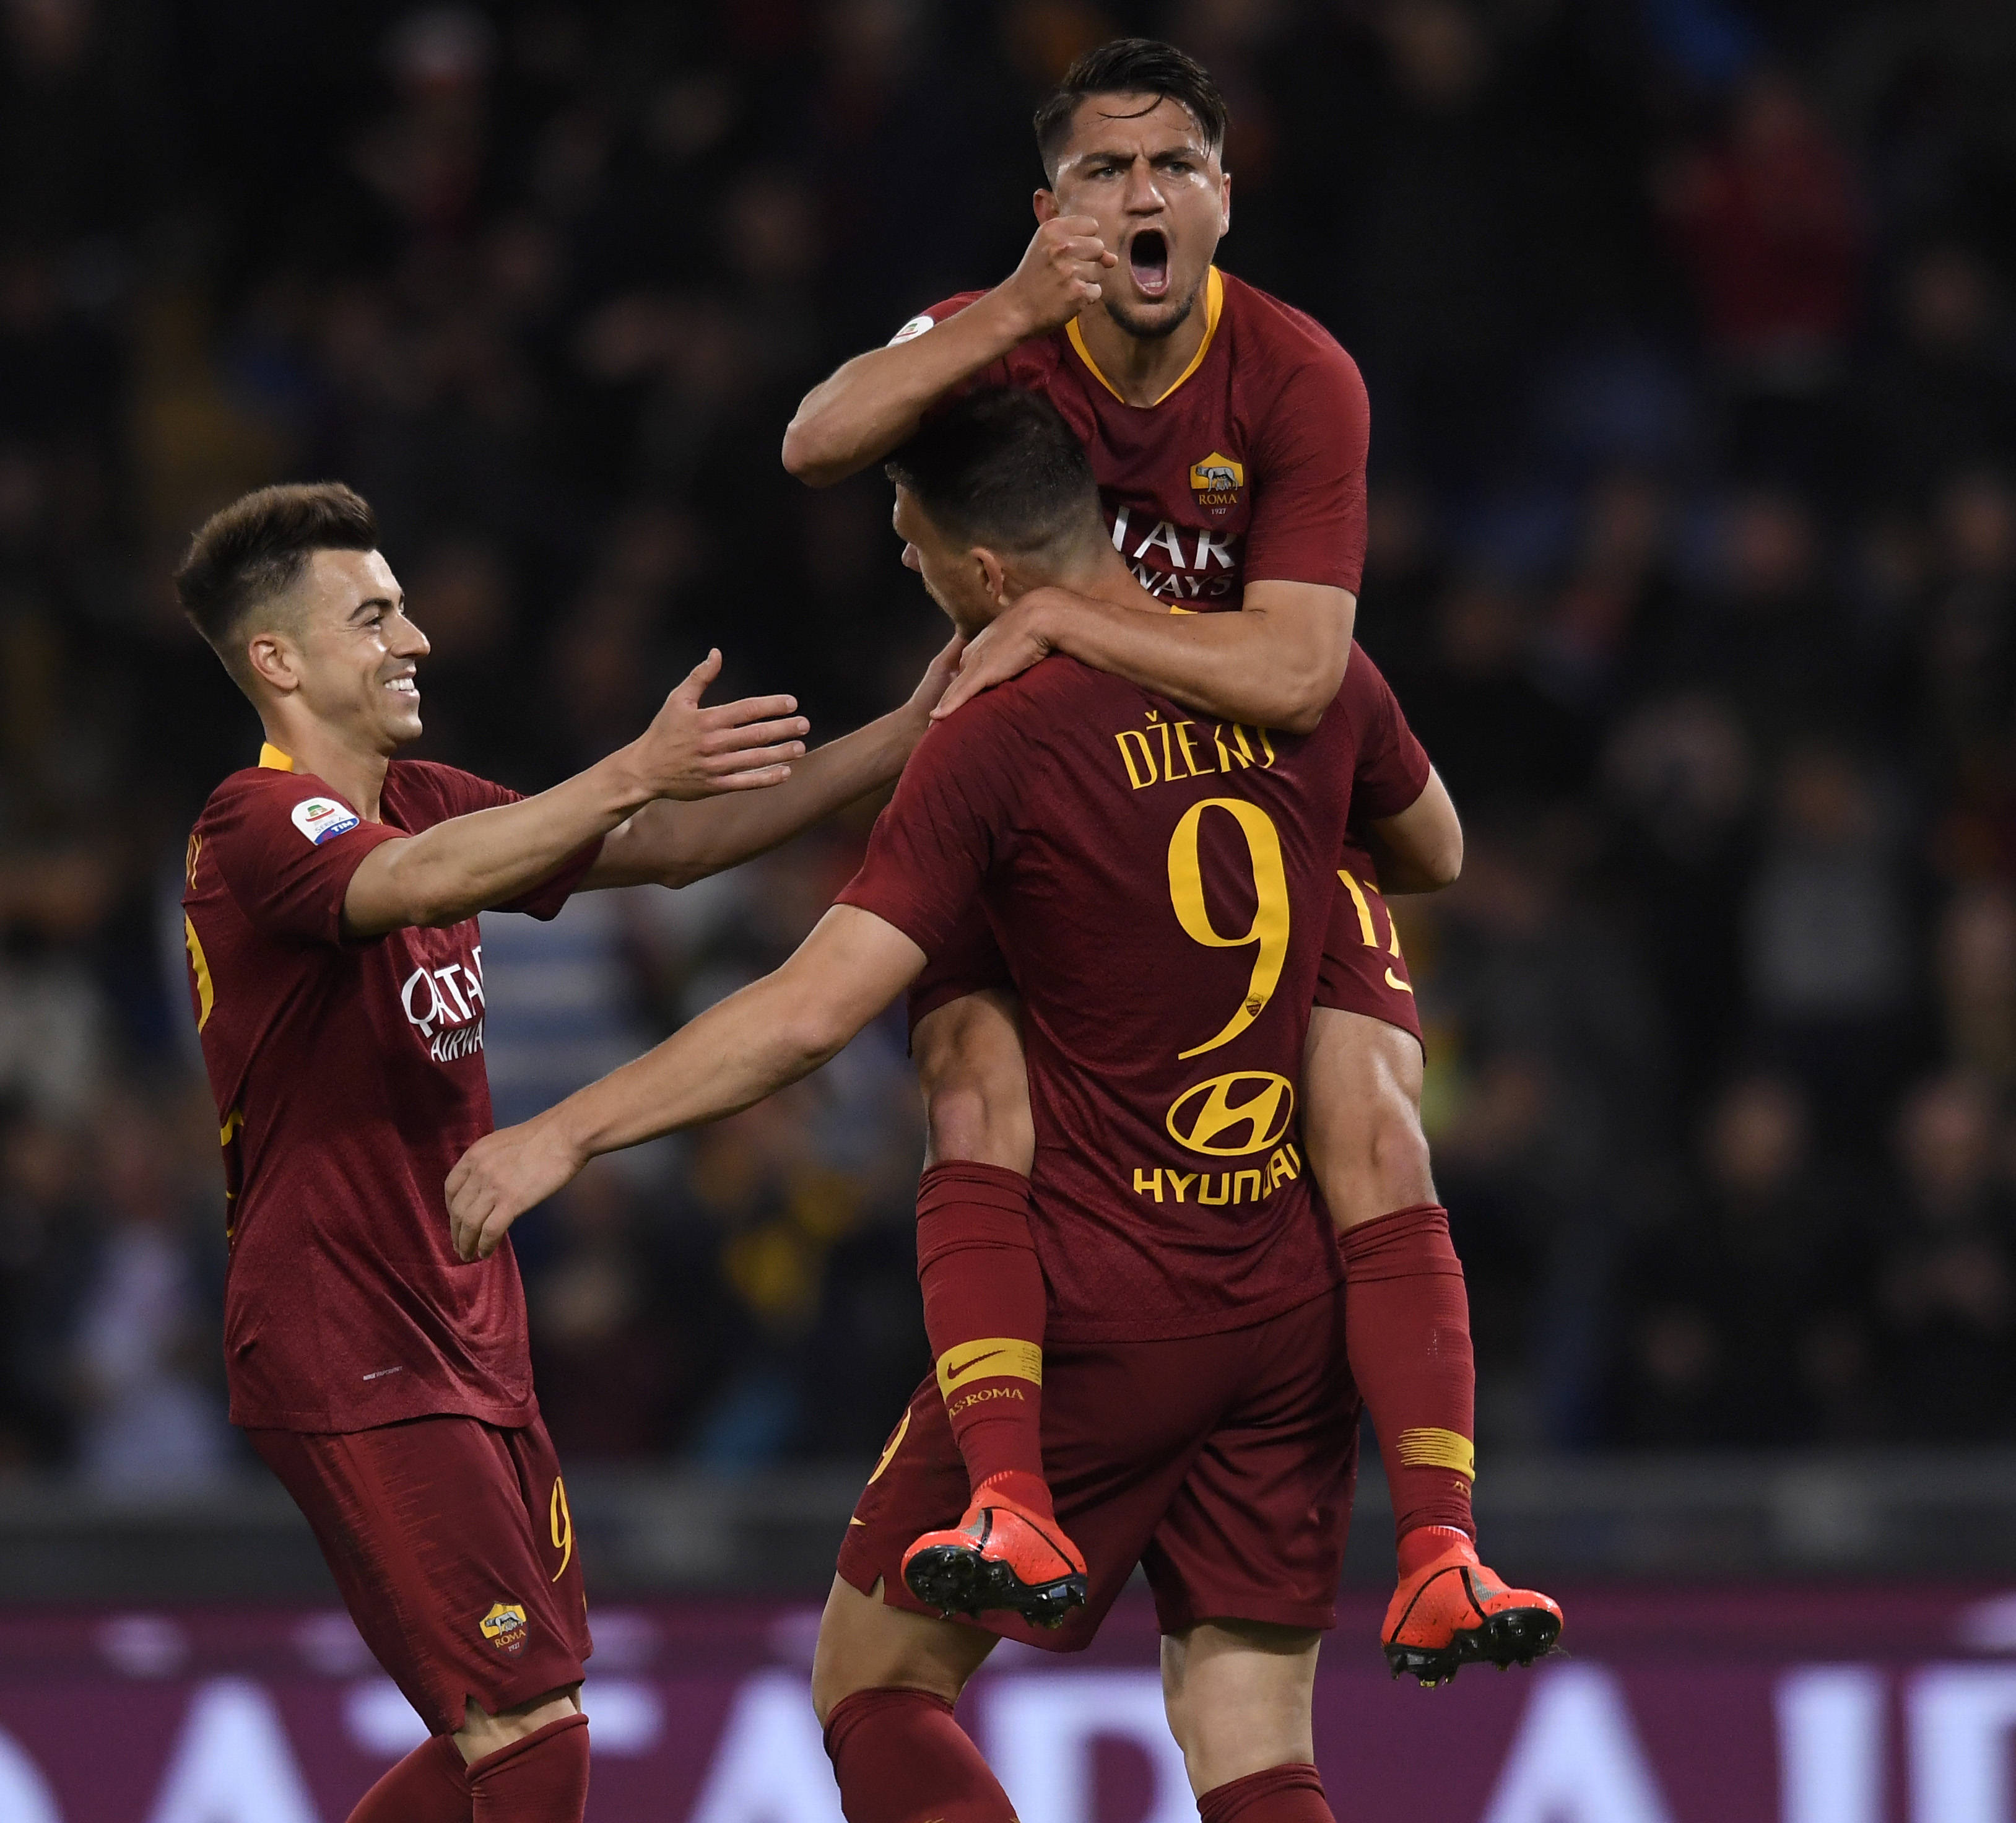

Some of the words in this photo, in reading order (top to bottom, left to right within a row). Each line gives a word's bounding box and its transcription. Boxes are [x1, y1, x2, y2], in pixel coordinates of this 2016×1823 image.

[1199, 493, 1238, 506] ROMA
[331, 820, 354, 832] TIM
[1168, 798, 1290, 1060] 9
[1133, 1143, 1301, 1206] HYUNDAI
[550, 1476, 571, 1583] 9
[495, 1629, 526, 1648] ROMA
